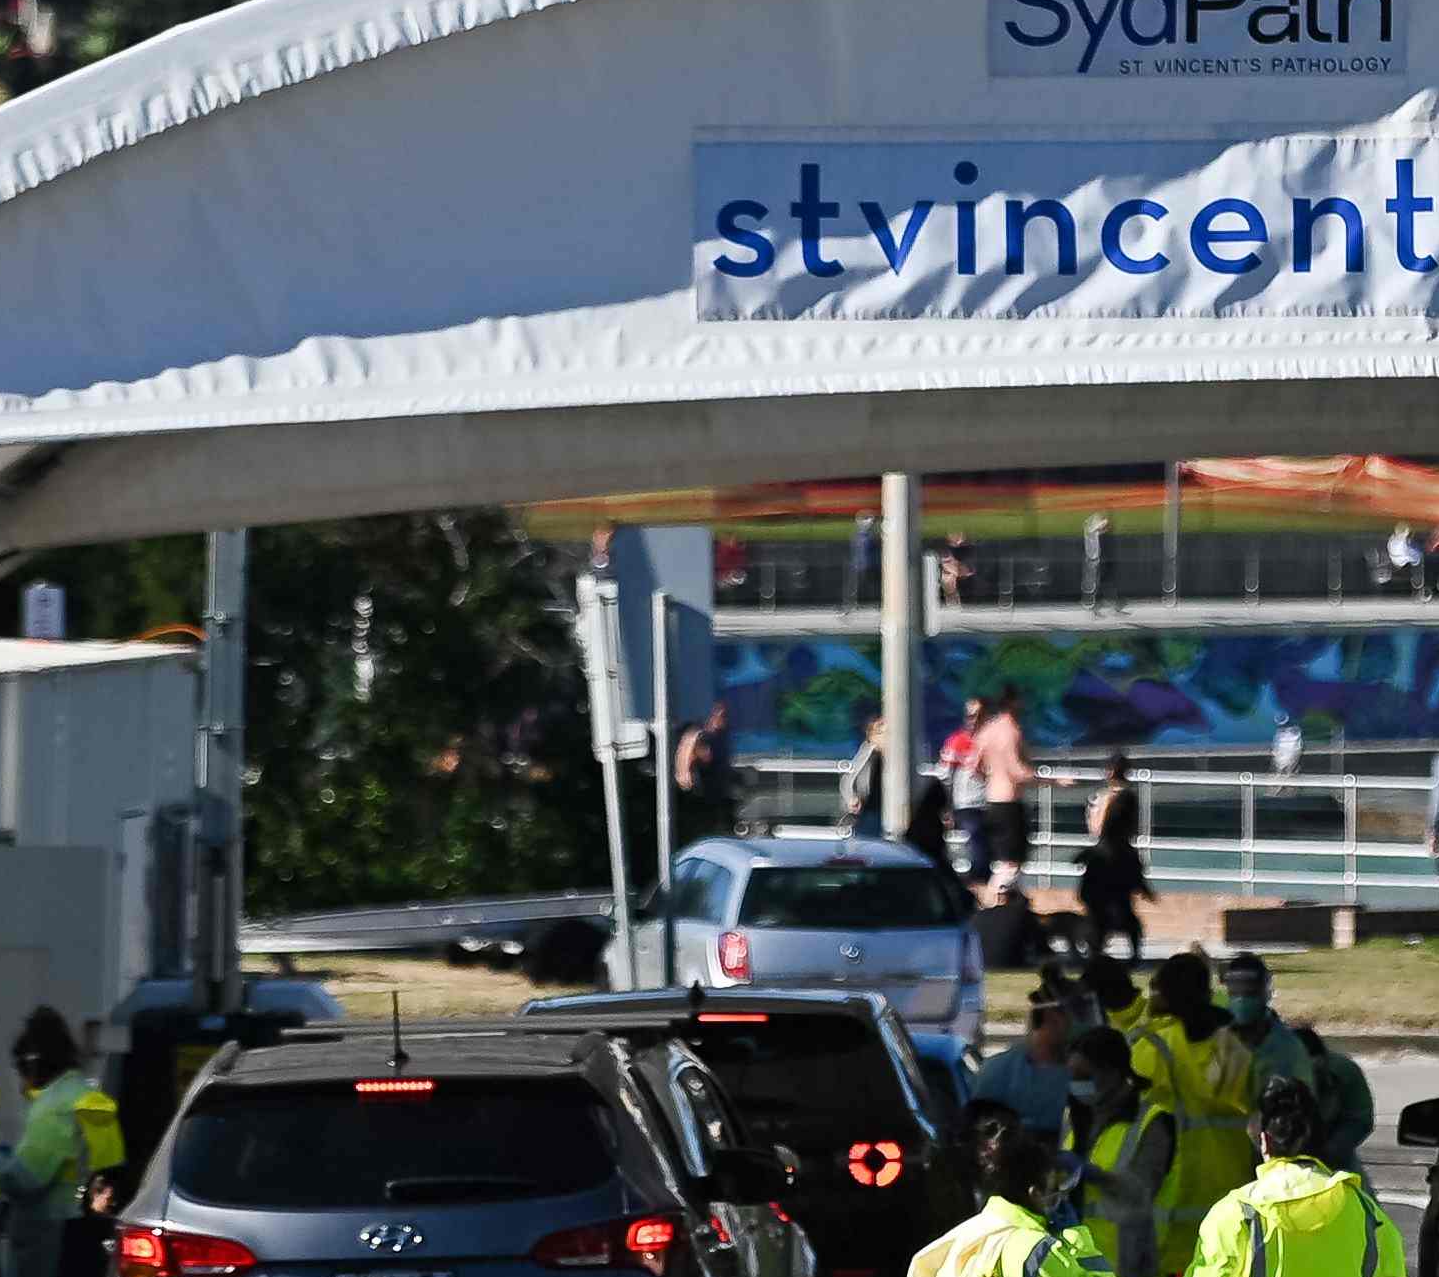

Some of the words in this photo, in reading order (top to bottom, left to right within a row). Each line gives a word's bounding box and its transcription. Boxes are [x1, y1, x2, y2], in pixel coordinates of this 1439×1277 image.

[1119, 59, 1144, 75] ST
[1154, 57, 1263, 75] VINCENT'S
[1271, 56, 1393, 74] PATHOLOGY
